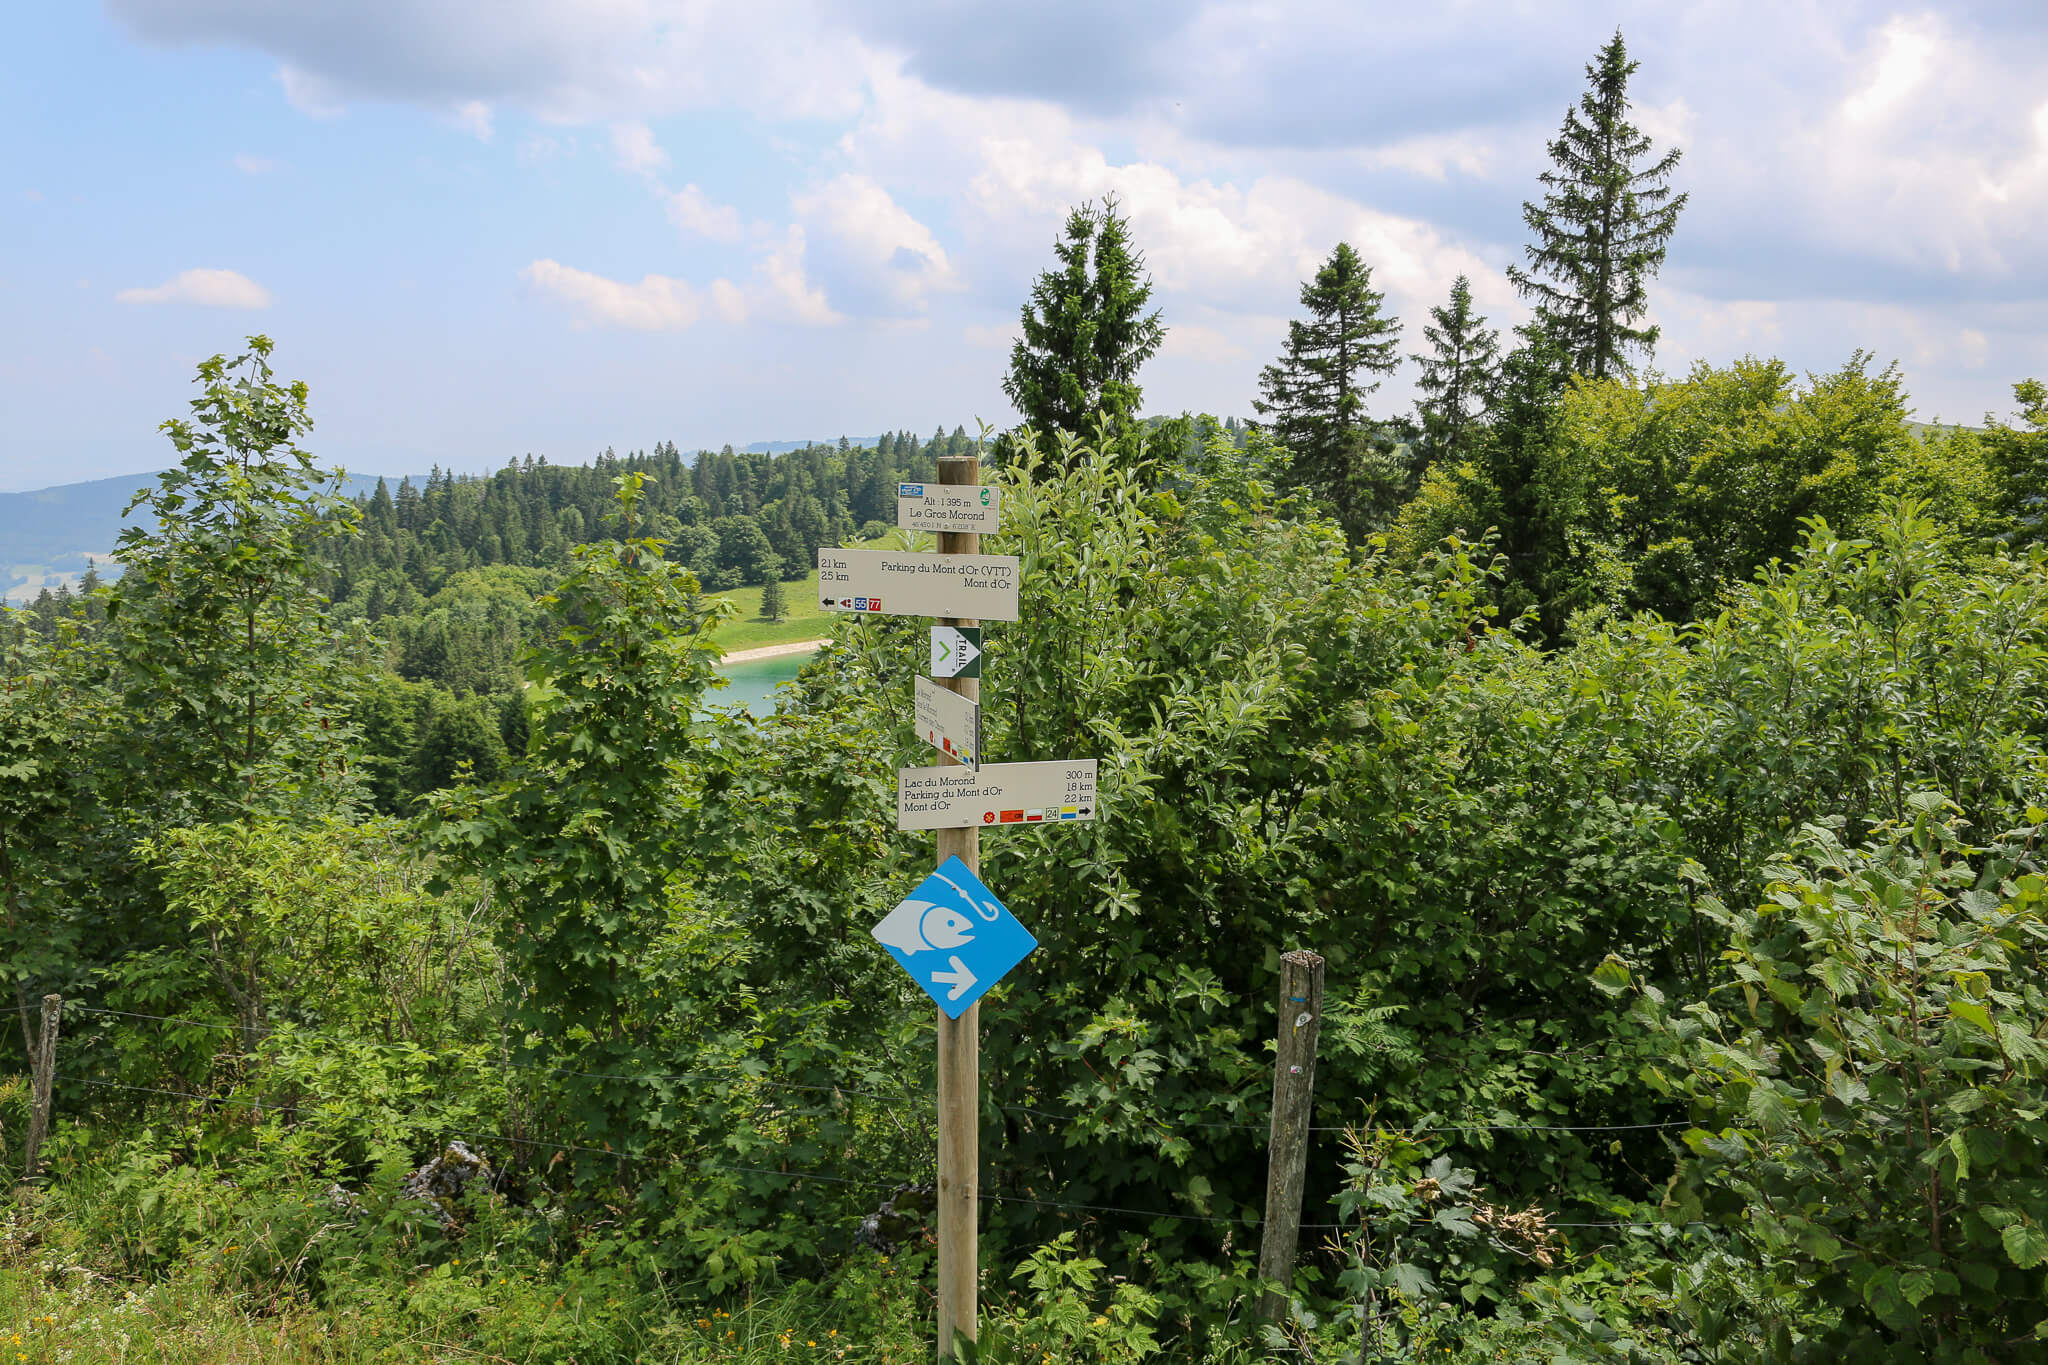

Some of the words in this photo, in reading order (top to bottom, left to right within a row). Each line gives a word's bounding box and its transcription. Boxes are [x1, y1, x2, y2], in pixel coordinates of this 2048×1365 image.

[923, 497, 936, 506] Alt
[946, 498, 962, 507] 395
[909, 508, 922, 517] Le
[924, 508, 947, 519] Gros
[949, 509, 985, 521] Morond
[833, 559, 847, 569] km
[881, 561, 916, 574] Parking
[917, 563, 930, 573] du
[932, 563, 956, 574] Mont
[981, 565, 1012, 577] (VTT)
[835, 571, 849, 581] km
[964, 577, 988, 588] Mont
[855, 599, 866, 609] 55
[870, 600, 880, 609] 77
[958, 639, 967, 668] TRAIL
[1065, 770, 1083, 780] 300
[904, 778, 922, 788] Lac
[924, 777, 937, 787] du
[939, 775, 976, 787] Morond
[1079, 781, 1093, 791] km
[904, 790, 940, 800] Parking
[942, 788, 954, 798] du
[956, 787, 980, 798] Mont
[1078, 793, 1092, 803] km
[904, 803, 928, 812] Mont
[1047, 809, 1057, 818] 24
